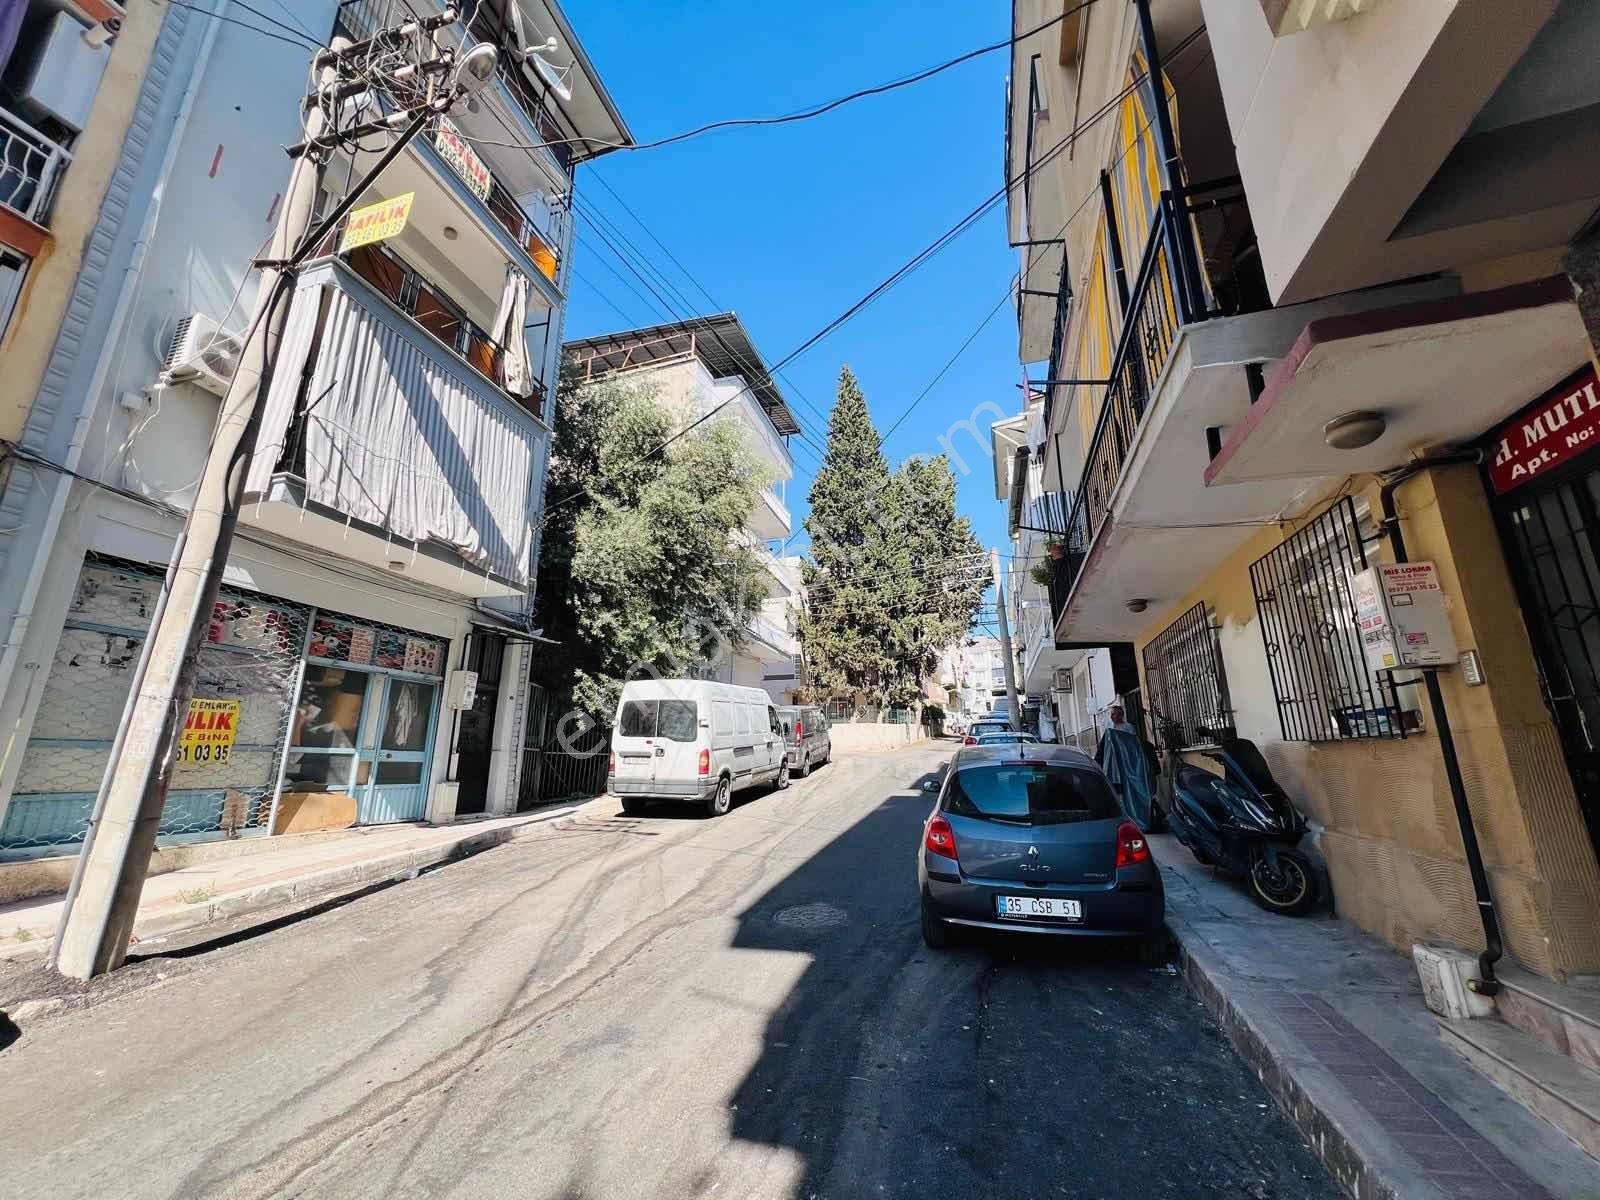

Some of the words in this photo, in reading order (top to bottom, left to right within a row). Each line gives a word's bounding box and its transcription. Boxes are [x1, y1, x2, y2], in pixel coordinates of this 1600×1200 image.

[1511, 449, 1558, 480] Apt.
[1565, 426, 1595, 448] No:
[194, 744, 211, 761] 03
[214, 744, 229, 761] 35
[1007, 897, 1023, 912] 35
[1030, 900, 1053, 914] CSB
[1063, 901, 1078, 915] 51
